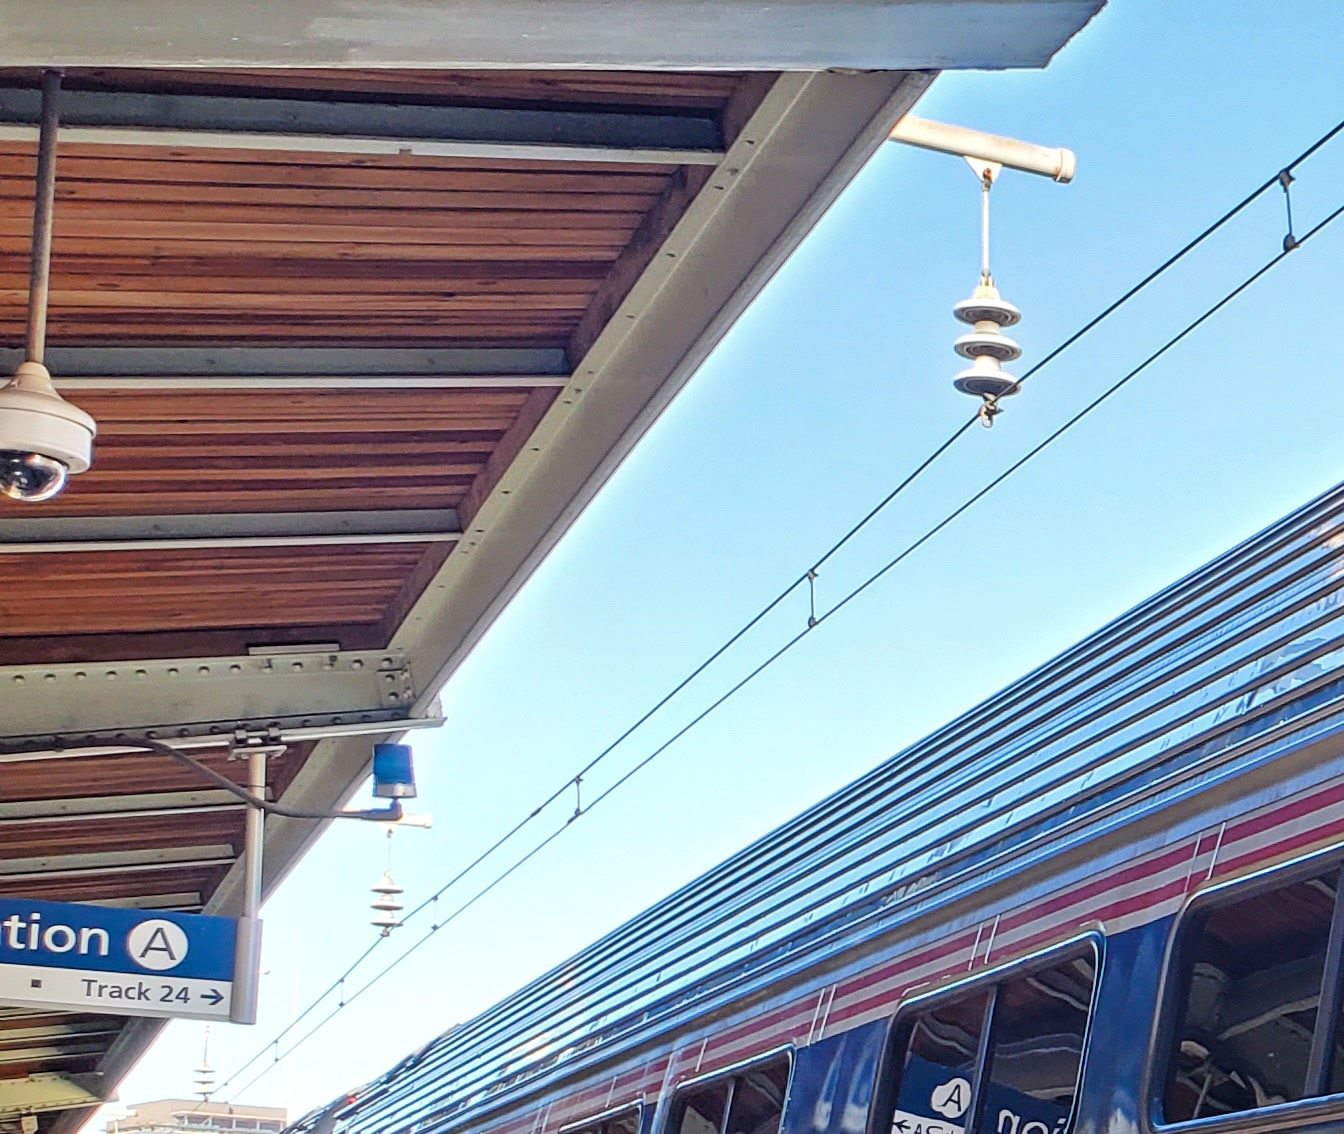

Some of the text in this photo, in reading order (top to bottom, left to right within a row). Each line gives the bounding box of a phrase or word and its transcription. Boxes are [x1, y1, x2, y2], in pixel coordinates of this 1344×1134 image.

[0, 912, 177, 961] tion A
[81, 978, 191, 1004] Track 24
